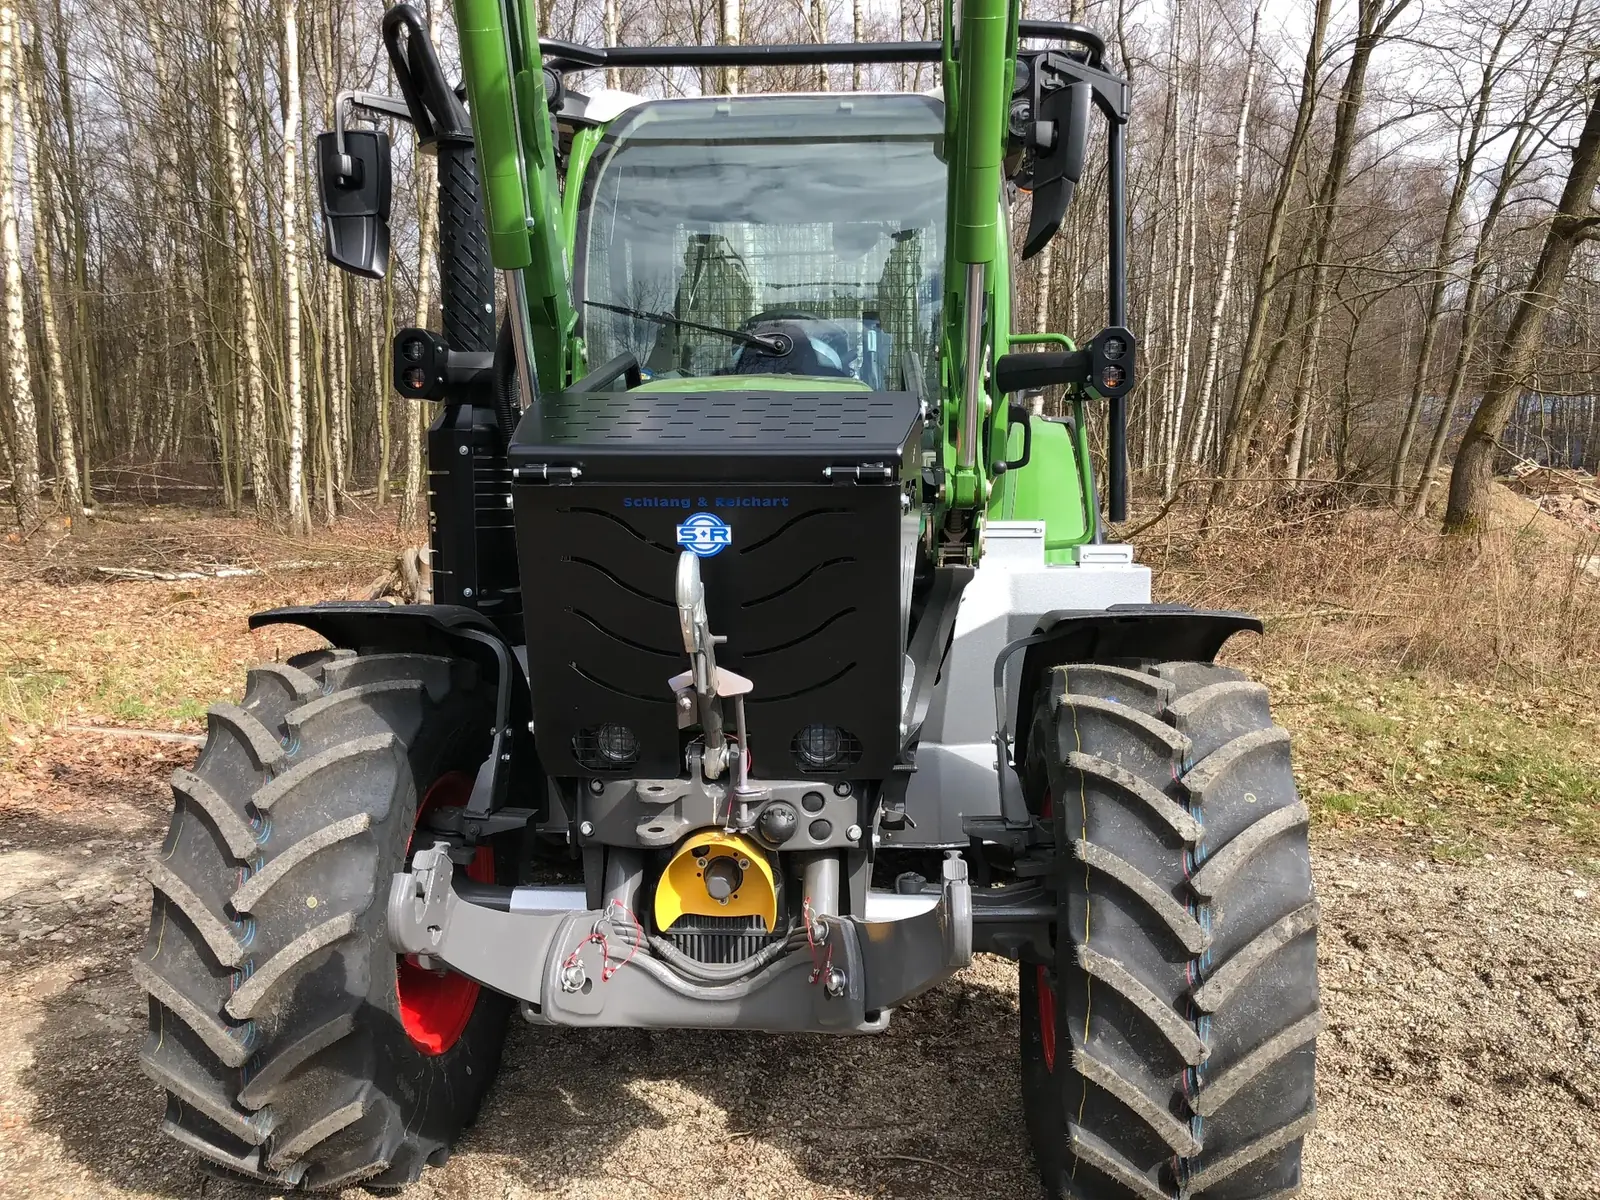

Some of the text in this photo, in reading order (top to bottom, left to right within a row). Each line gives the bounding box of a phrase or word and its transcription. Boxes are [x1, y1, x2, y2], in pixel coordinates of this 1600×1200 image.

[623, 497, 789, 509] Schlang & Reichart
